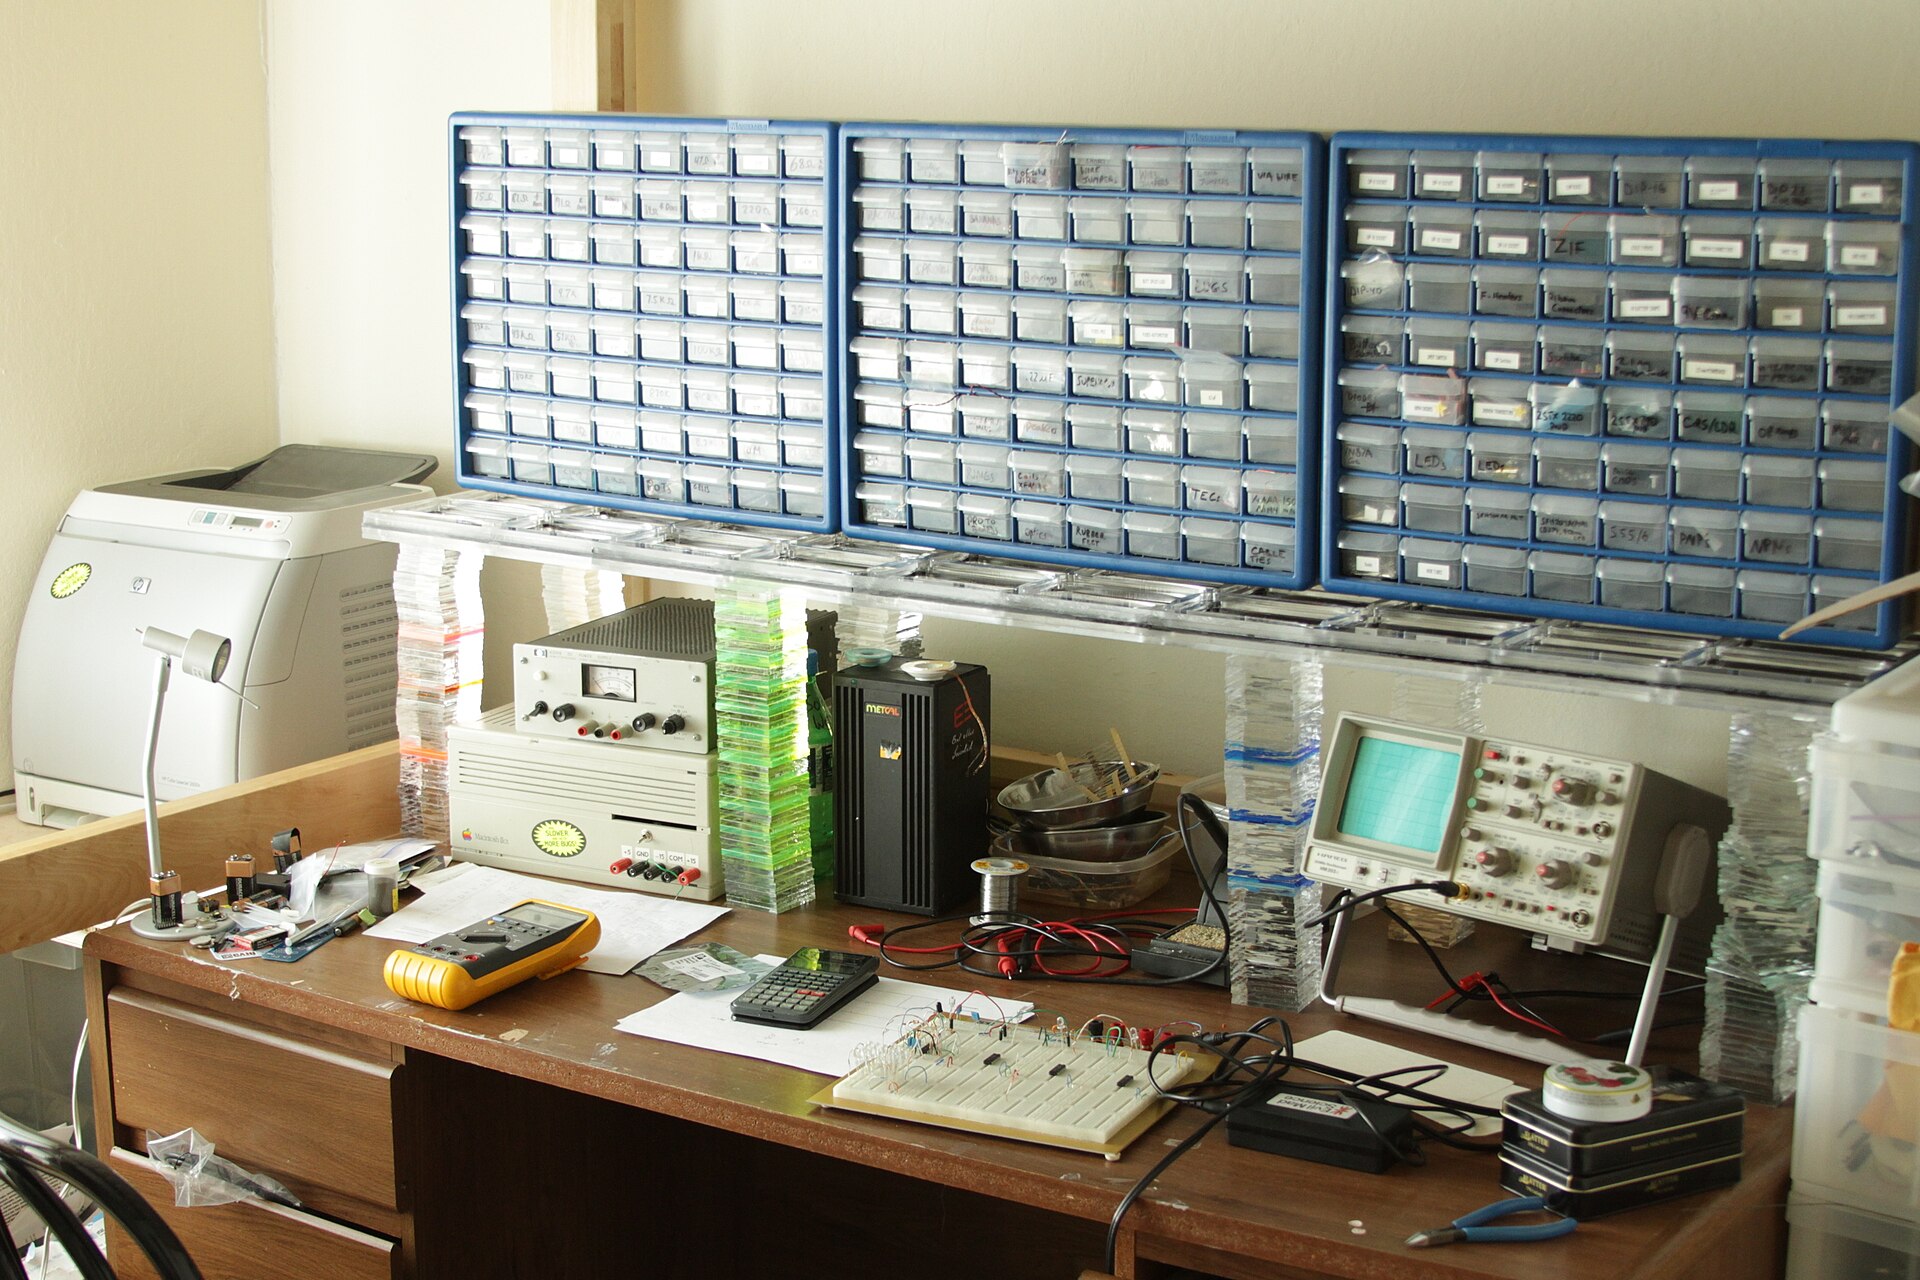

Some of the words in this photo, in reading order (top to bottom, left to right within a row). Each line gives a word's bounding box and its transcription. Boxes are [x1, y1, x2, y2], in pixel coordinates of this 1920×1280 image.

[865, 704, 900, 717] METCAL
[545, 829, 569, 837] SLOWER
[544, 839, 559, 847] MORE
[636, 850, 649, 858] GND
[668, 854, 683, 862] COM
